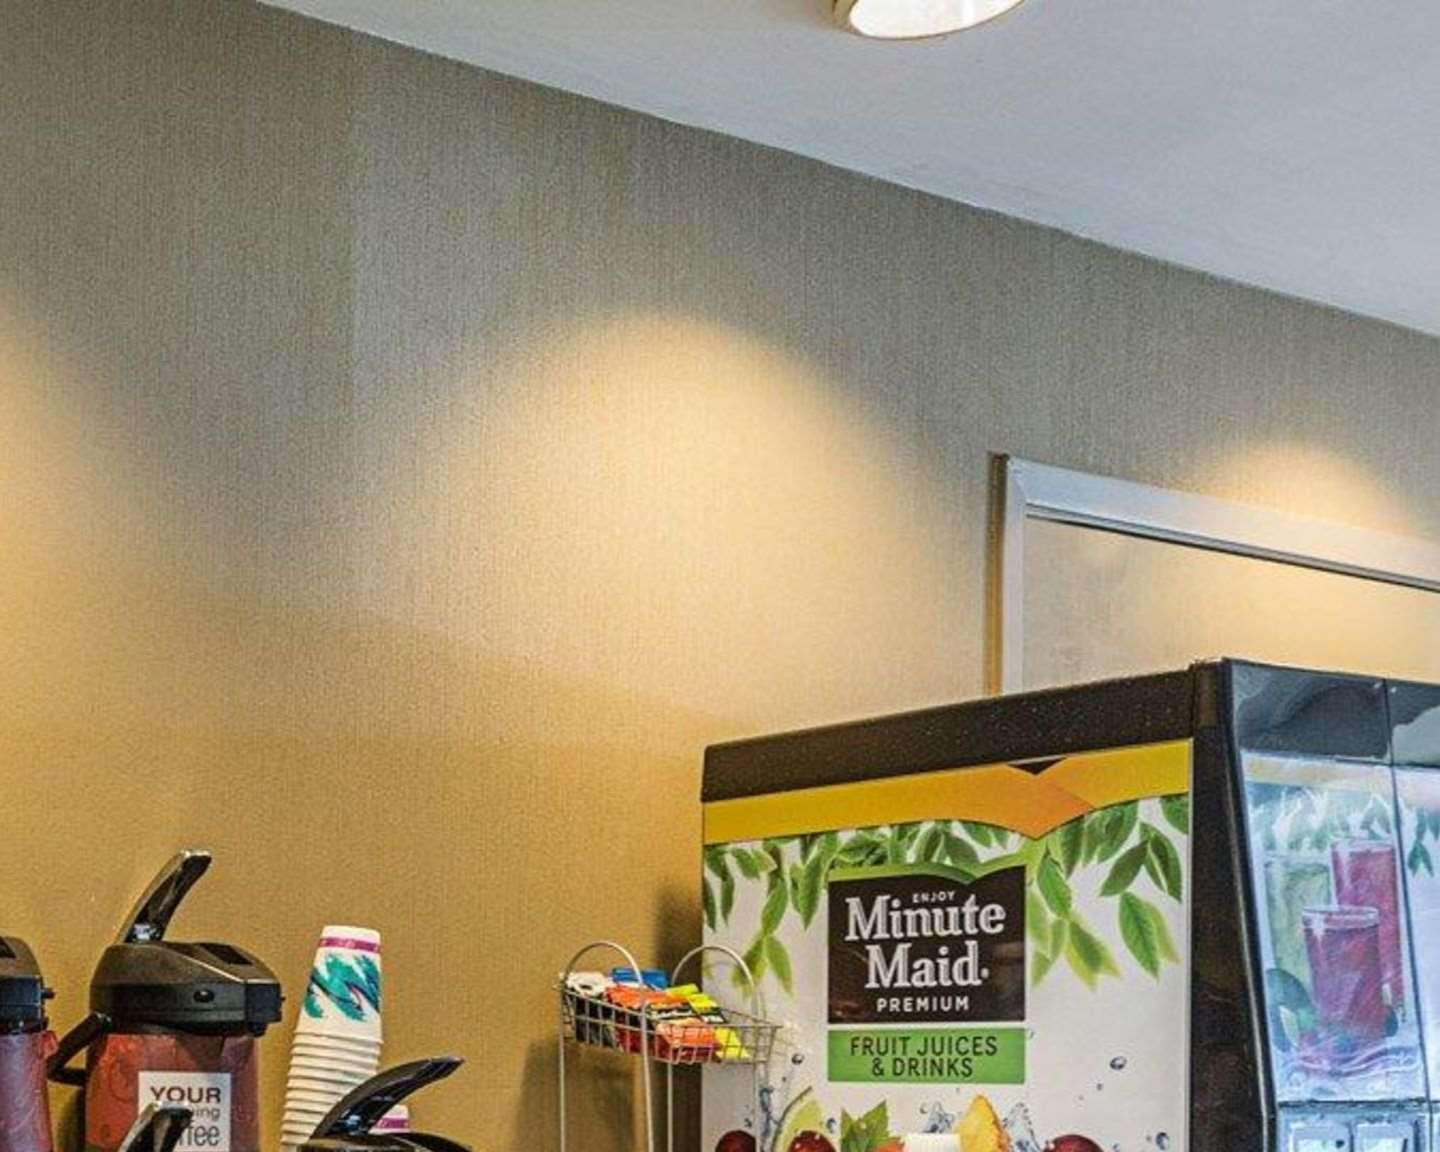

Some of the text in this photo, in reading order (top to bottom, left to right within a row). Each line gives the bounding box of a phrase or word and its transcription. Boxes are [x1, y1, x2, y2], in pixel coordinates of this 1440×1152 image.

[912, 890, 957, 903] ENJOY
[844, 893, 1007, 941] Minute
[864, 939, 984, 989] Maid
[876, 996, 970, 1012] PREMIUM
[849, 1035, 999, 1057] FRUIT JUICES
[871, 1056, 974, 1078] & DRINKS
[149, 1085, 222, 1104] YOUR
